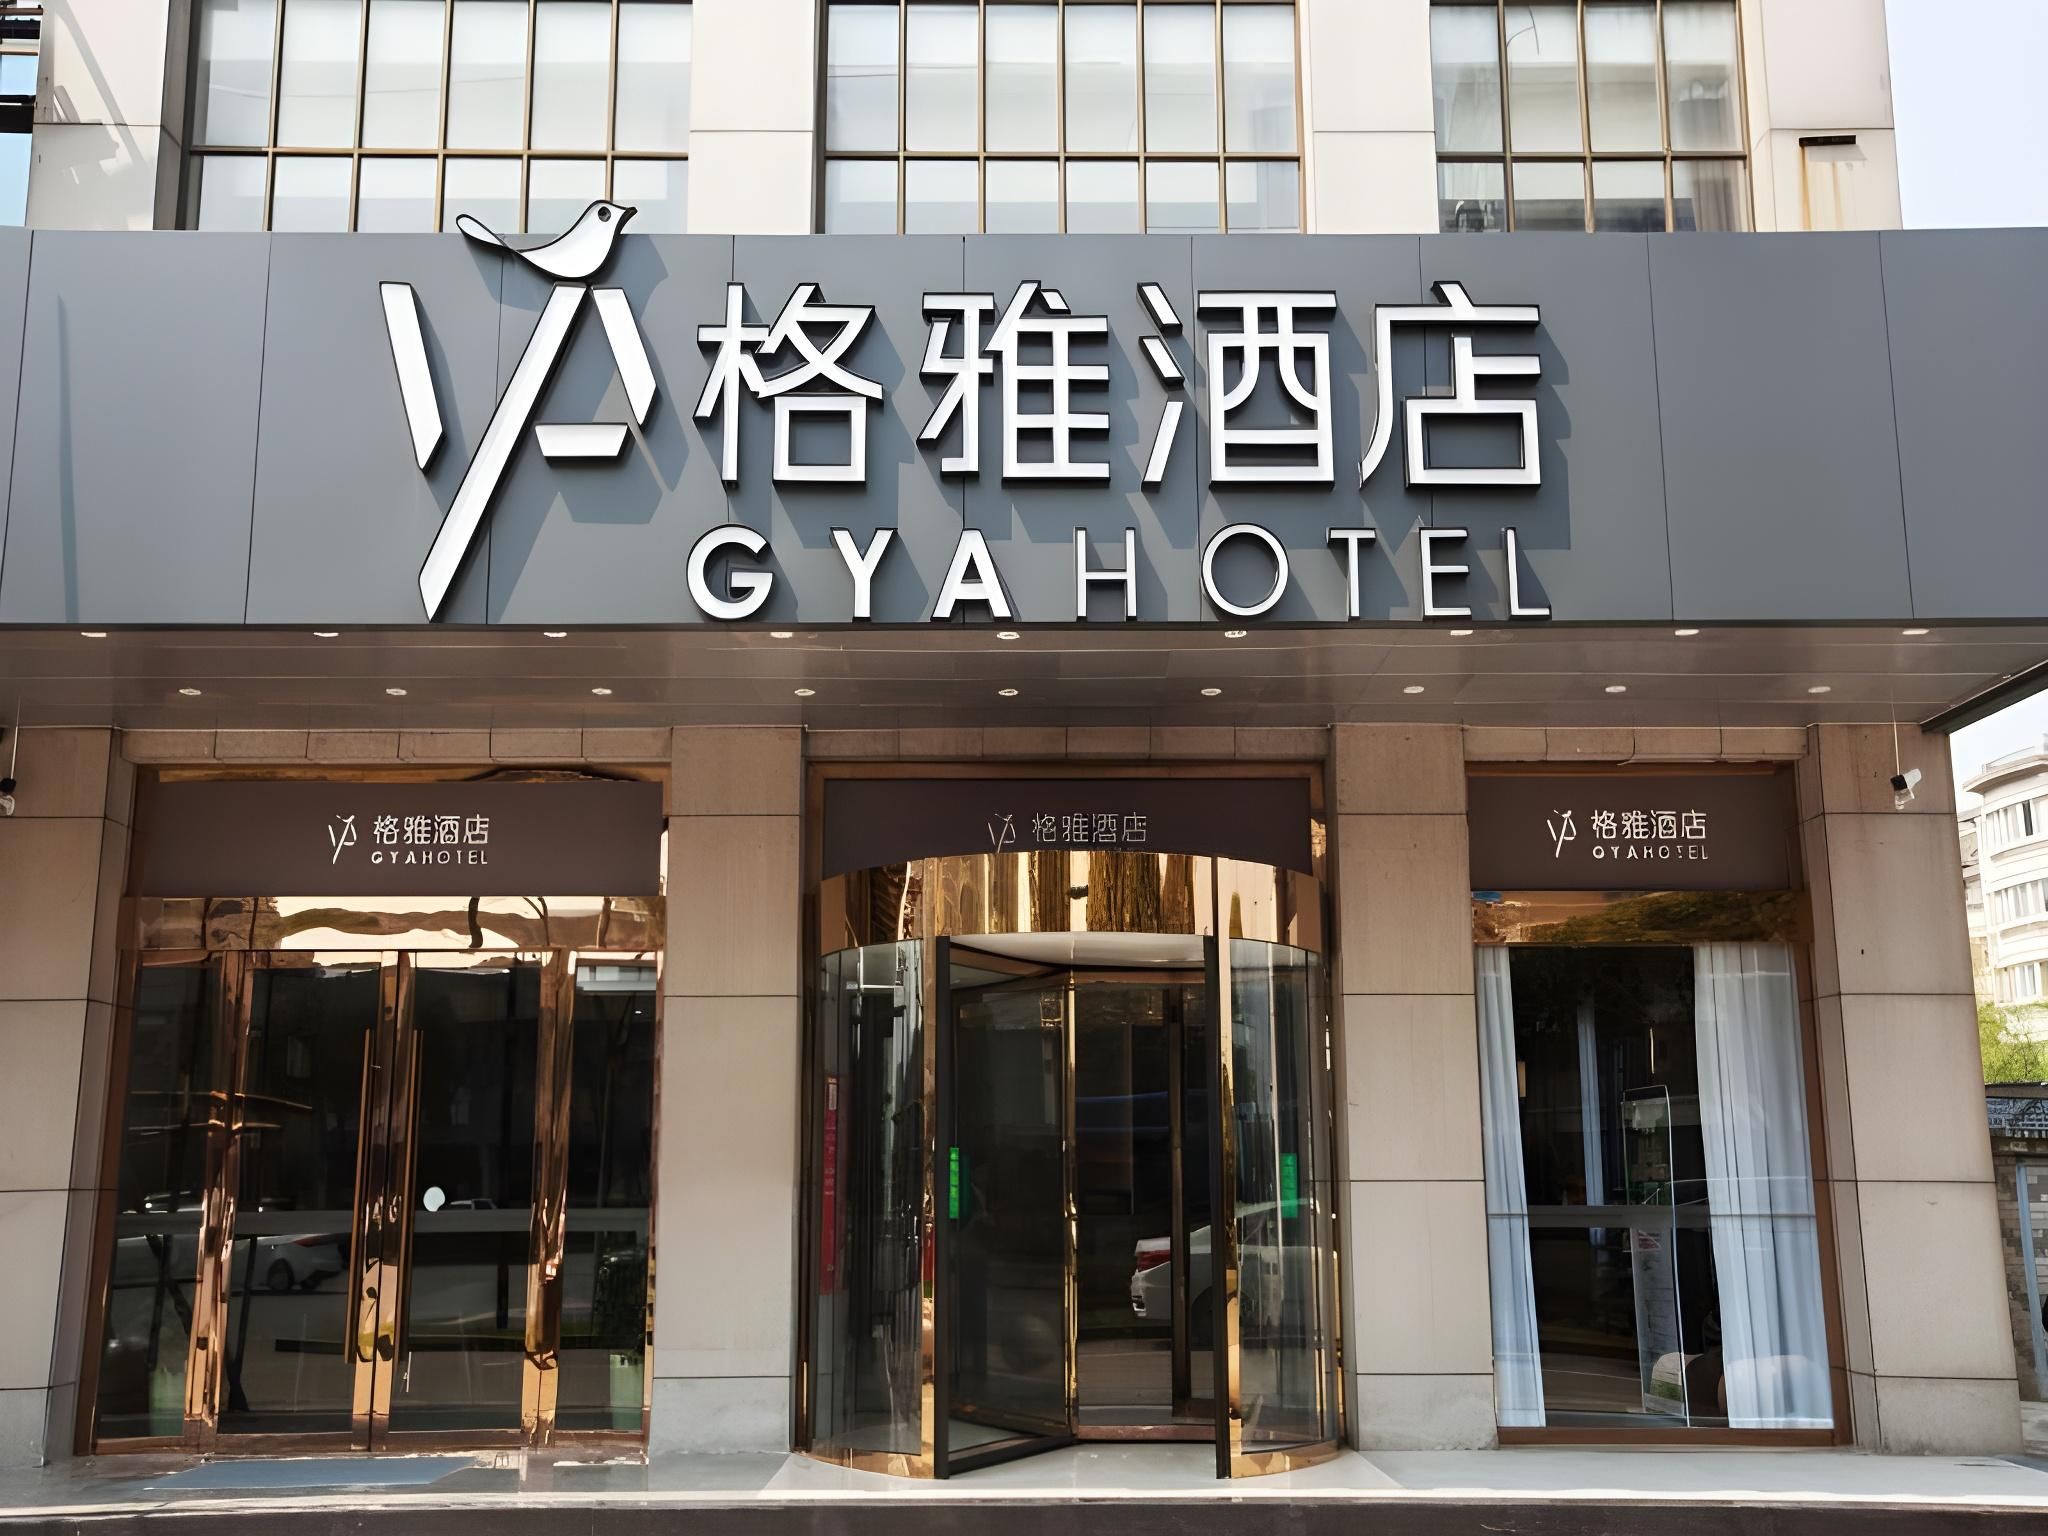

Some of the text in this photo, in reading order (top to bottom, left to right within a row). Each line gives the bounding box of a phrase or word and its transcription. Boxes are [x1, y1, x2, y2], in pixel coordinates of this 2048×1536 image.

[693, 280, 1540, 489] 格雅酒店
[686, 523, 1552, 622] GYAHOTEL
[373, 814, 489, 845] 格雅酒店
[1590, 809, 1707, 839] 格雅酒店
